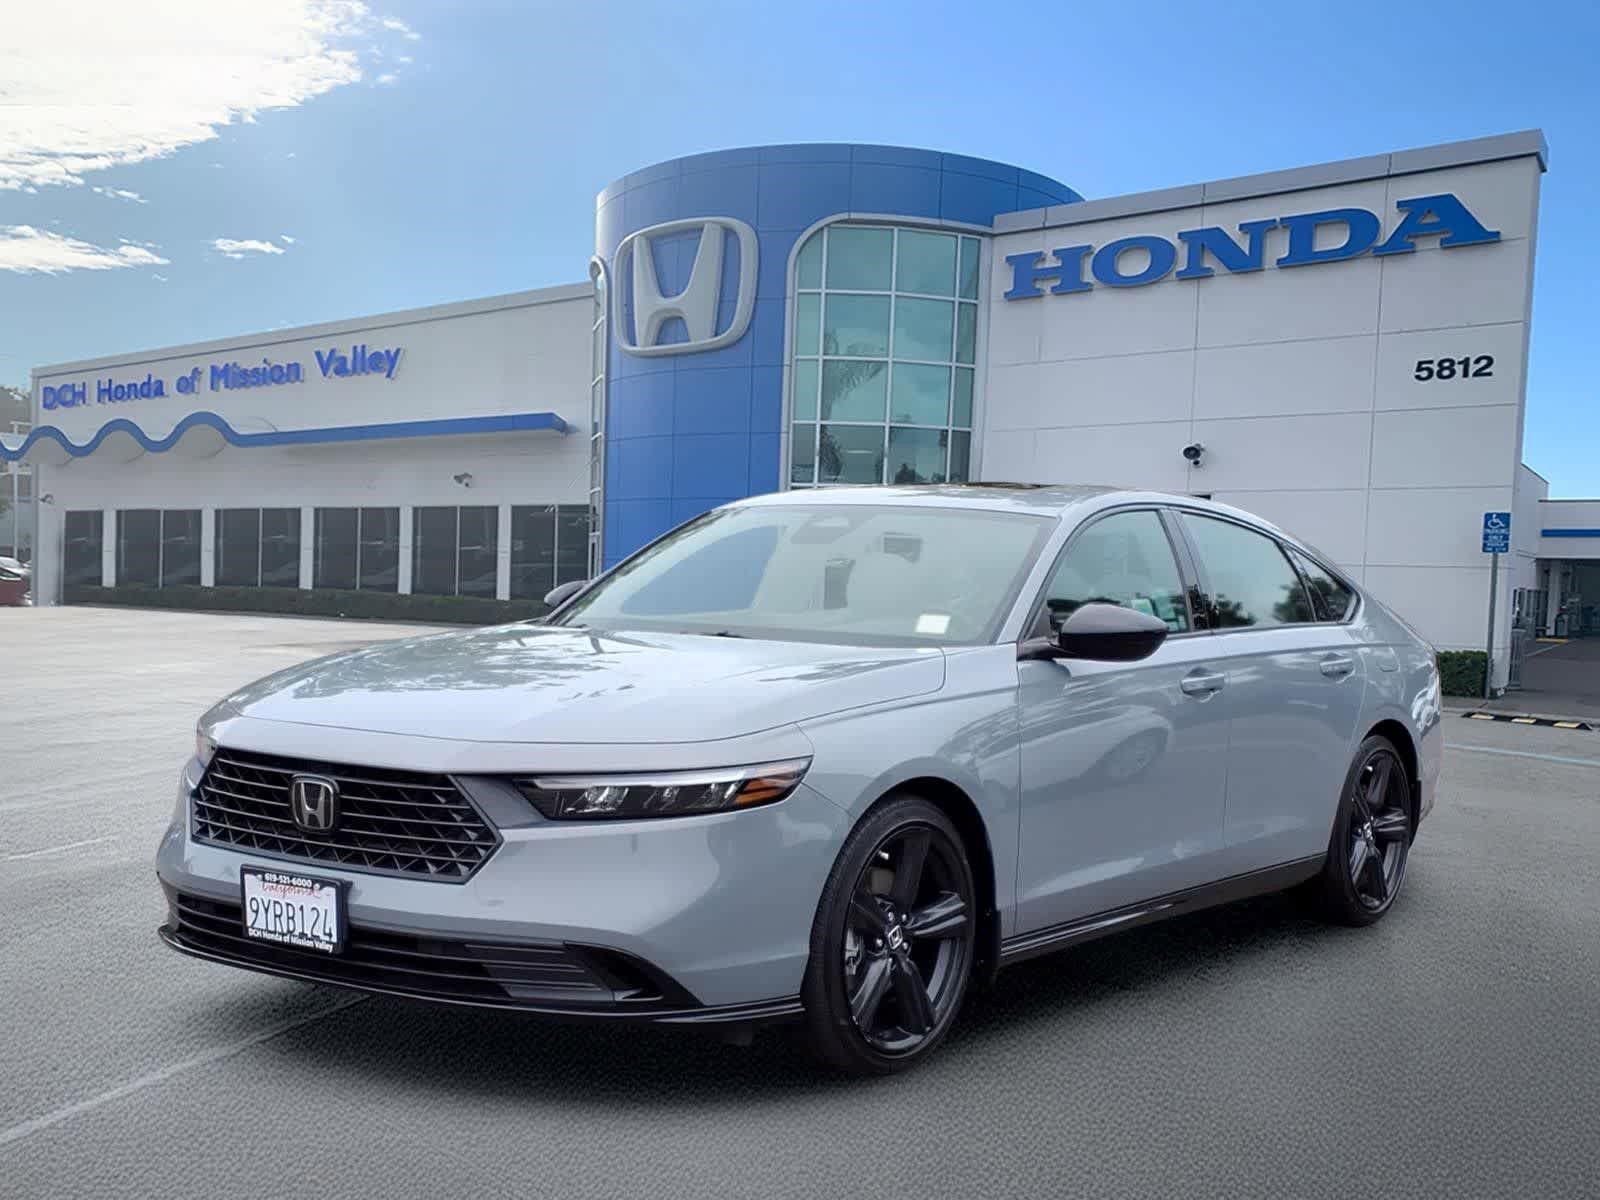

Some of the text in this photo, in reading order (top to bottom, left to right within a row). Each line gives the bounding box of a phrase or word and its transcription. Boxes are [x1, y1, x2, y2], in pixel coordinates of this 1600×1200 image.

[1004, 192, 1501, 300] HONDA
[42, 344, 401, 410] DCH Honda of Mission Valley
[1414, 355, 1495, 381] 5812
[249, 896, 334, 941] 9YRB124
